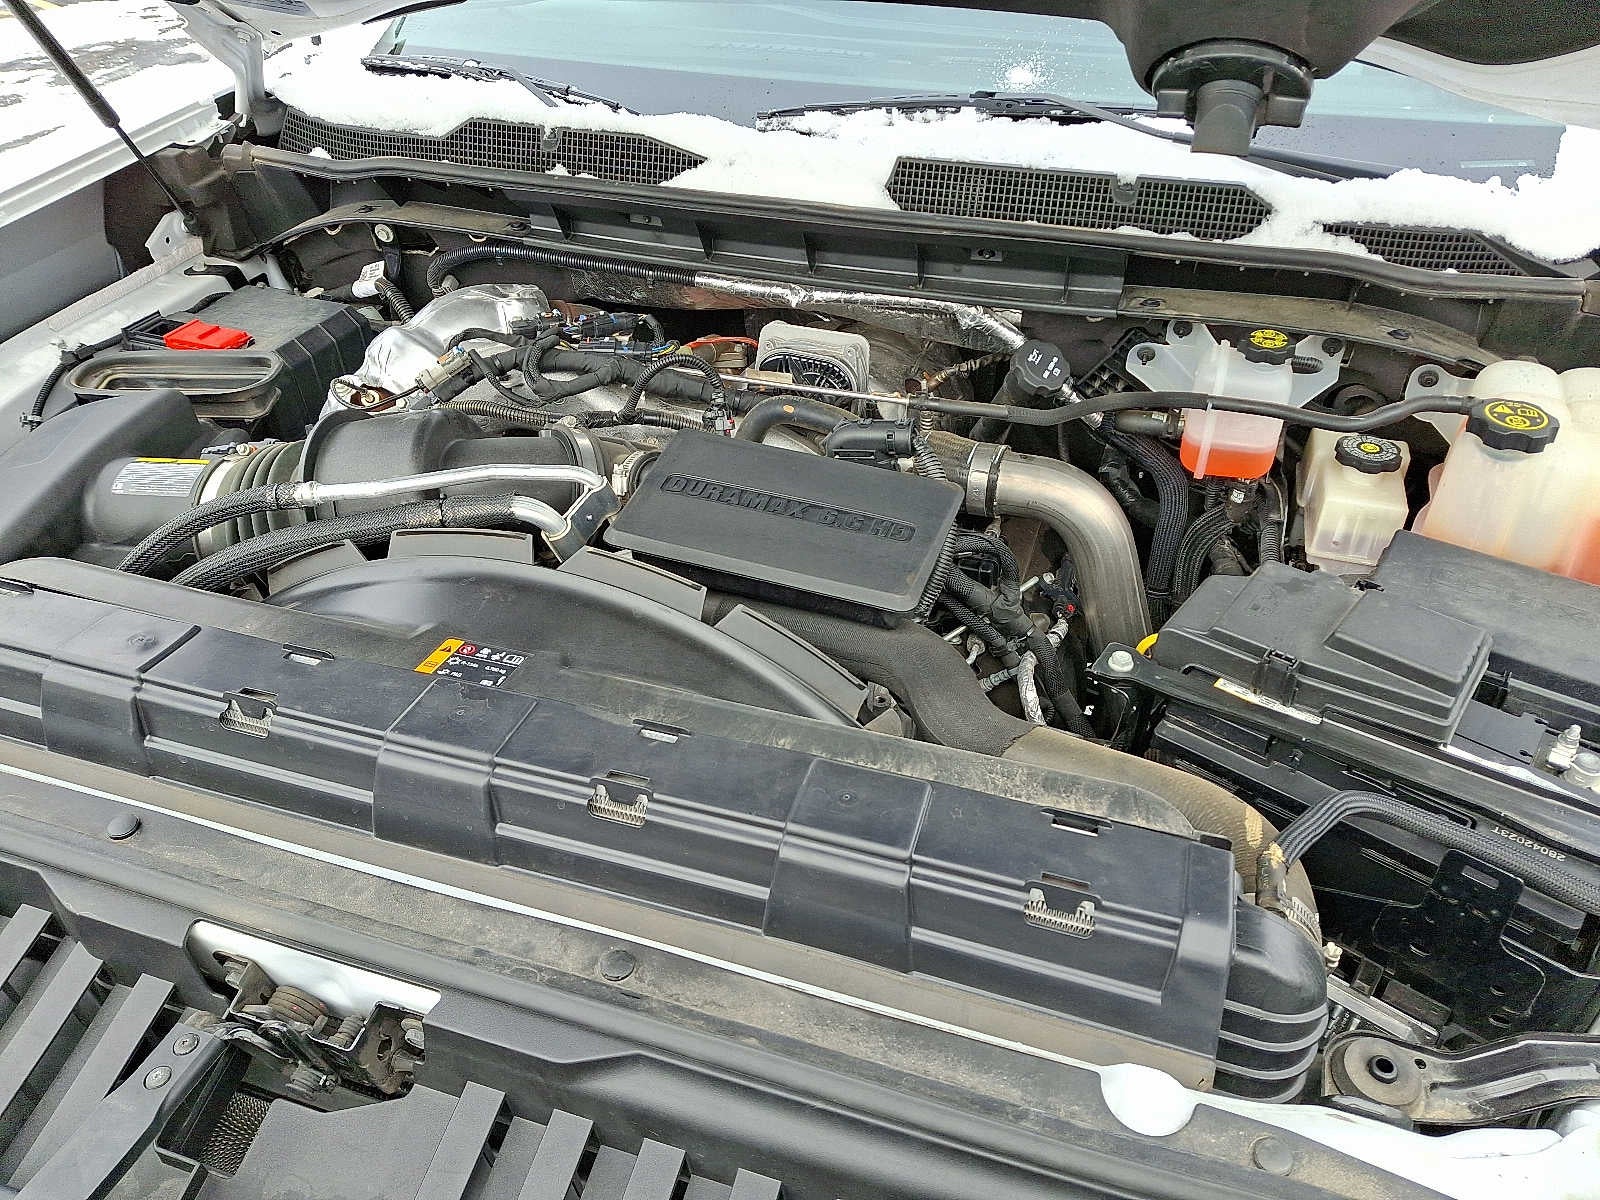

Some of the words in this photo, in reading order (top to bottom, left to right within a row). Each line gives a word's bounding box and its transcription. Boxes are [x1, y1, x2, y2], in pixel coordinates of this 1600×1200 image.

[664, 476, 809, 520] DURAMAX
[817, 509, 864, 531] 6.6
[871, 519, 914, 541] HD
[1490, 826, 1566, 861] 28042023T
